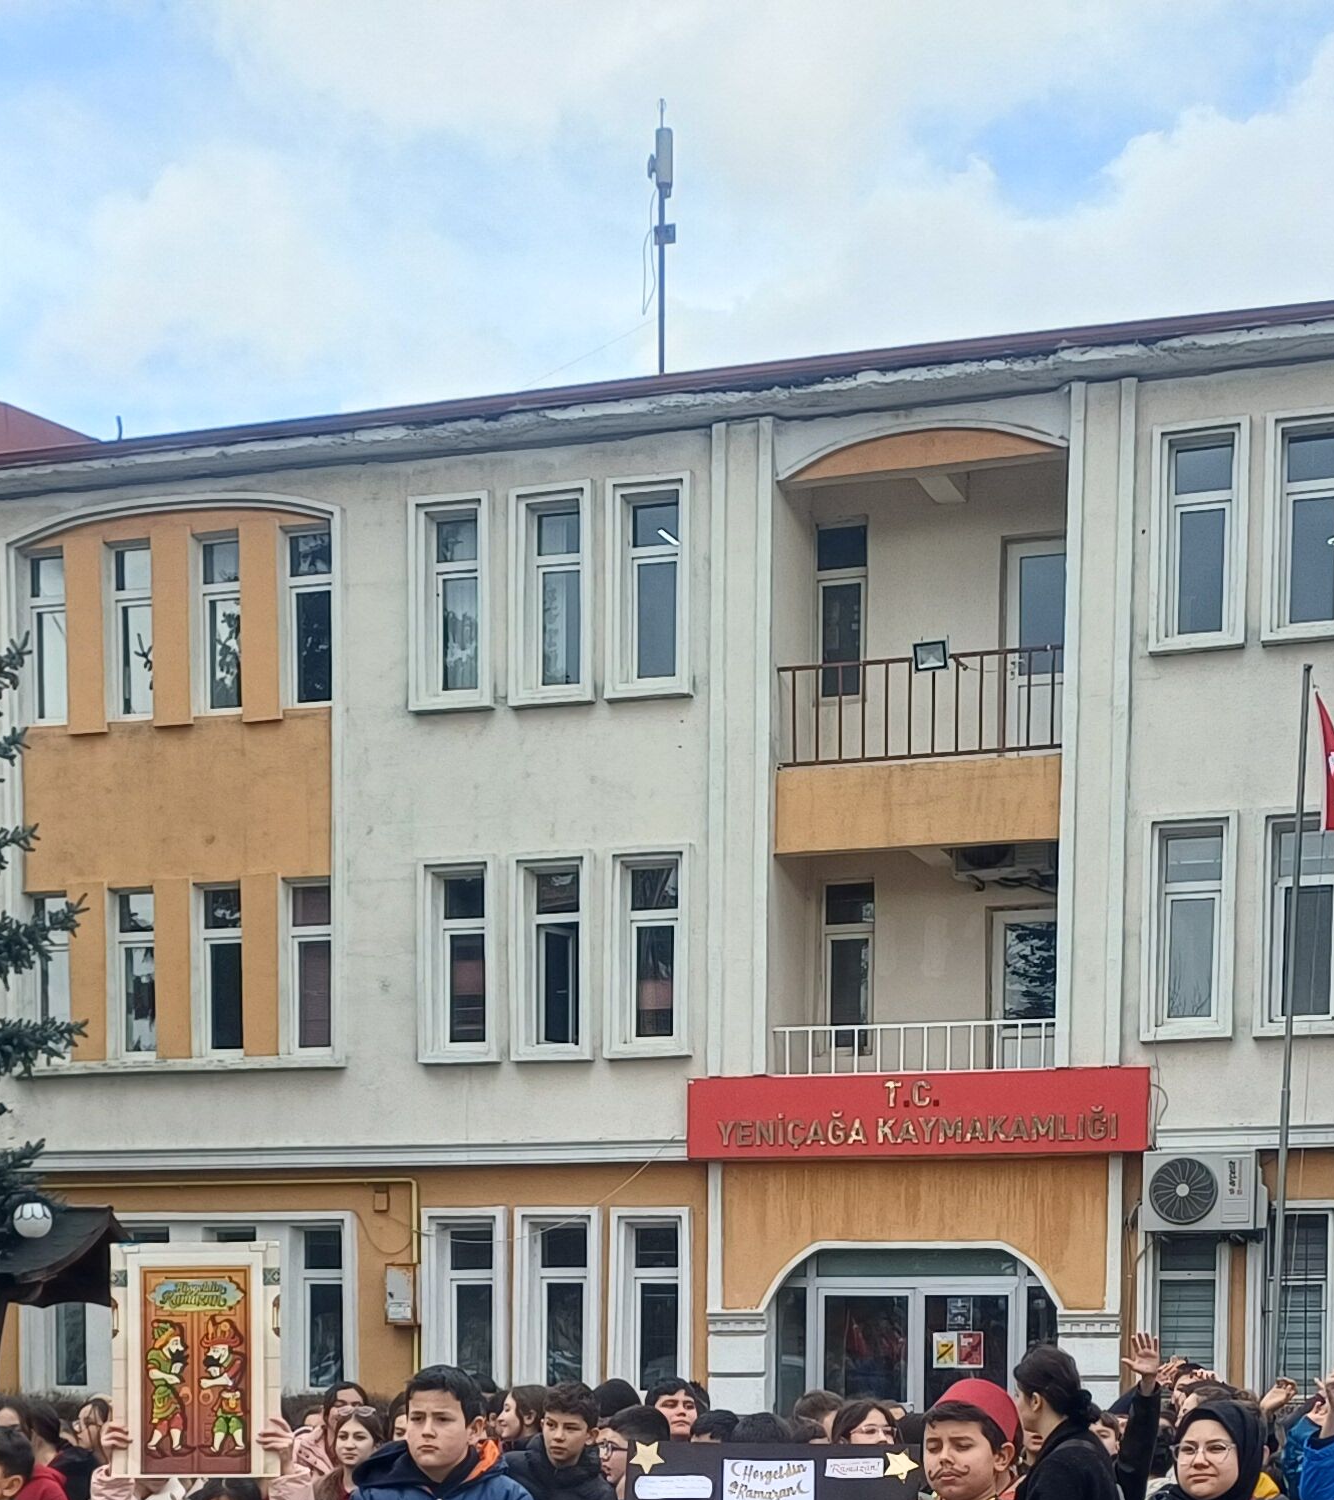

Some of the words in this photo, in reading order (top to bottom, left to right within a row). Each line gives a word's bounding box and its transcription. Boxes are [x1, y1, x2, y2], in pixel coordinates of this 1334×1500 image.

[884, 1080, 940, 1108] T.C.
[717, 1110, 868, 1149] YENİÇAĞA
[877, 1105, 1118, 1144] KAYMAKAMLIĞI
